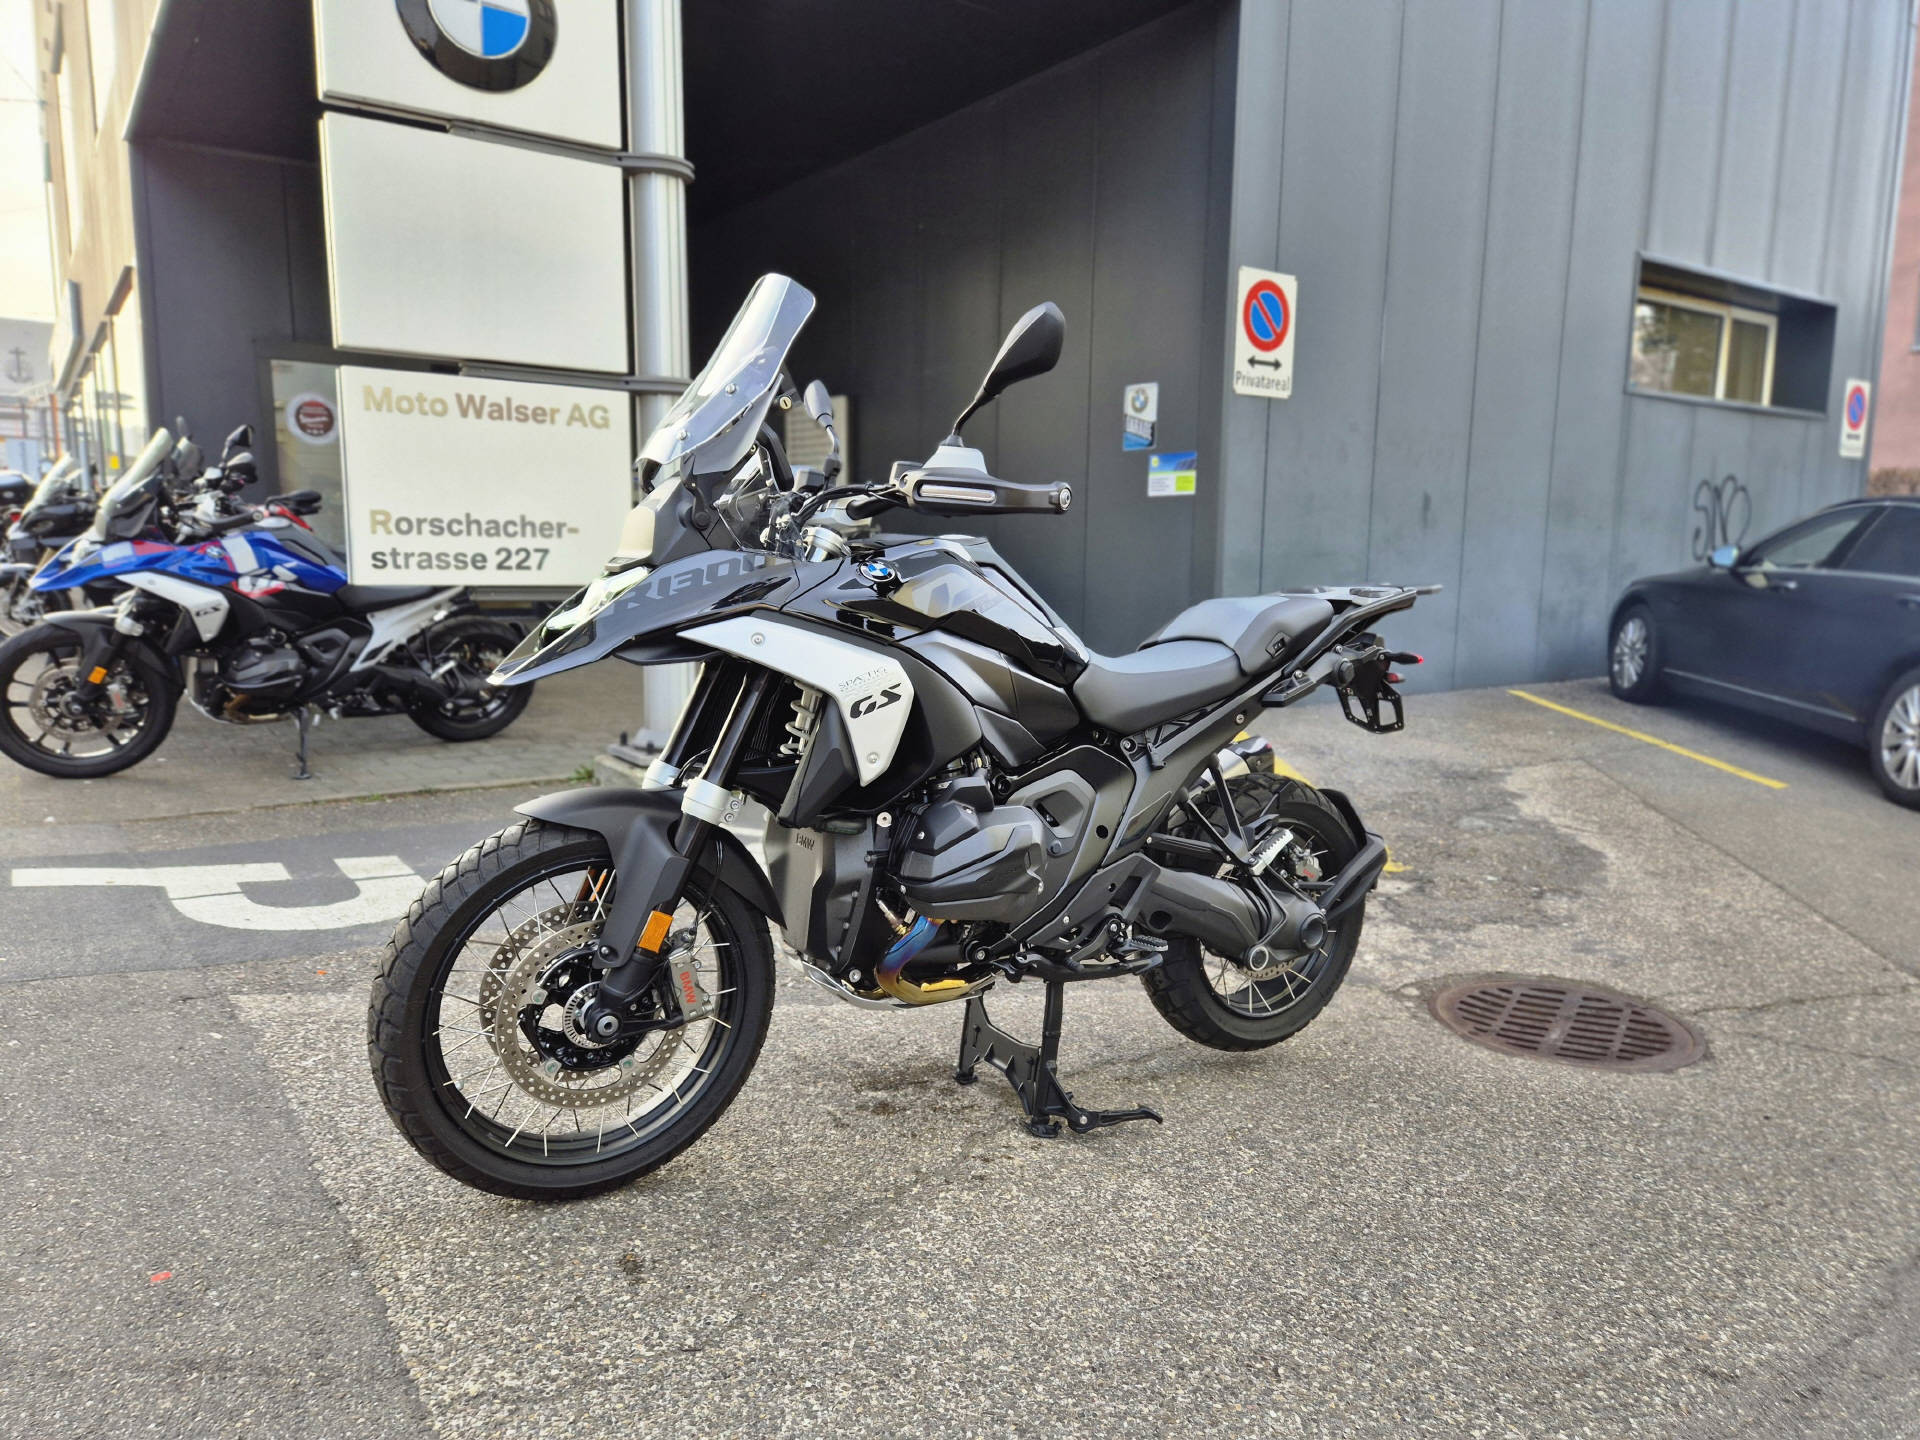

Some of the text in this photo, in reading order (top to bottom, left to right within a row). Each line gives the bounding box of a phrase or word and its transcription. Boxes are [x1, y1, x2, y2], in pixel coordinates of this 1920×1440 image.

[1235, 370, 1289, 391] Privatareal
[362, 384, 611, 429] Moto Walser AG
[369, 509, 580, 539] Rorschacher-
[371, 547, 550, 571] strasse 227
[850, 682, 902, 719] GS
[680, 971, 697, 1004] BMW
